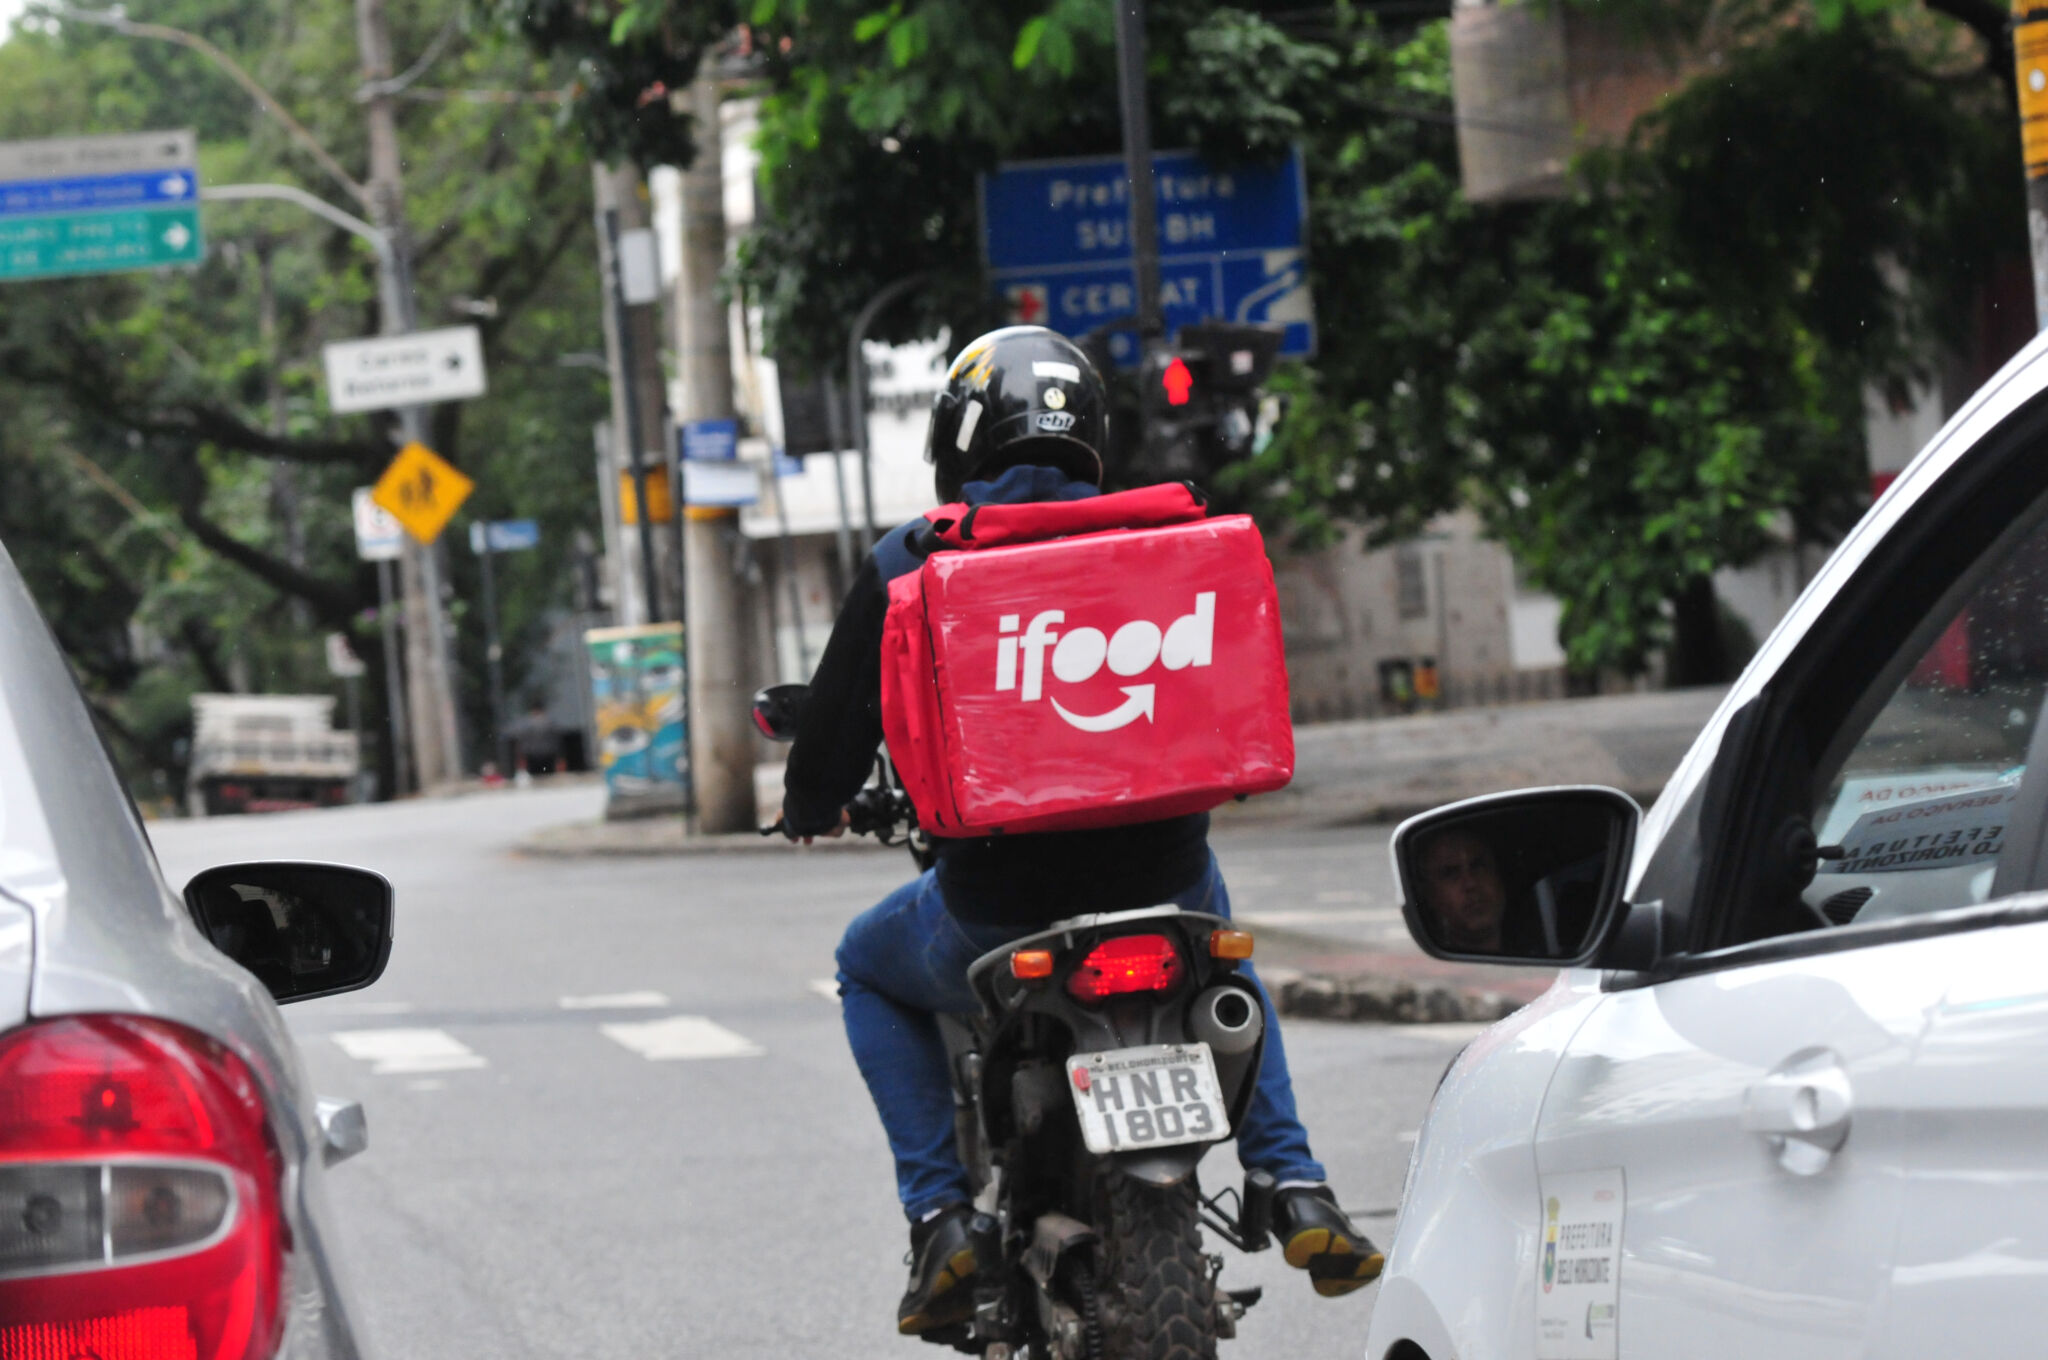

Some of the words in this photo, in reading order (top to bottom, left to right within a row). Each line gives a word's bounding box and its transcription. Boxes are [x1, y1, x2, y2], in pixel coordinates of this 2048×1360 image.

[1052, 172, 1235, 210] Preftura
[1061, 277, 1199, 317] CERAT
[995, 591, 1216, 702] ifood
[1091, 1067, 1201, 1113] HNR
[1103, 1102, 1214, 1147] 1803
[1560, 1222, 1613, 1250] PREFEITURA
